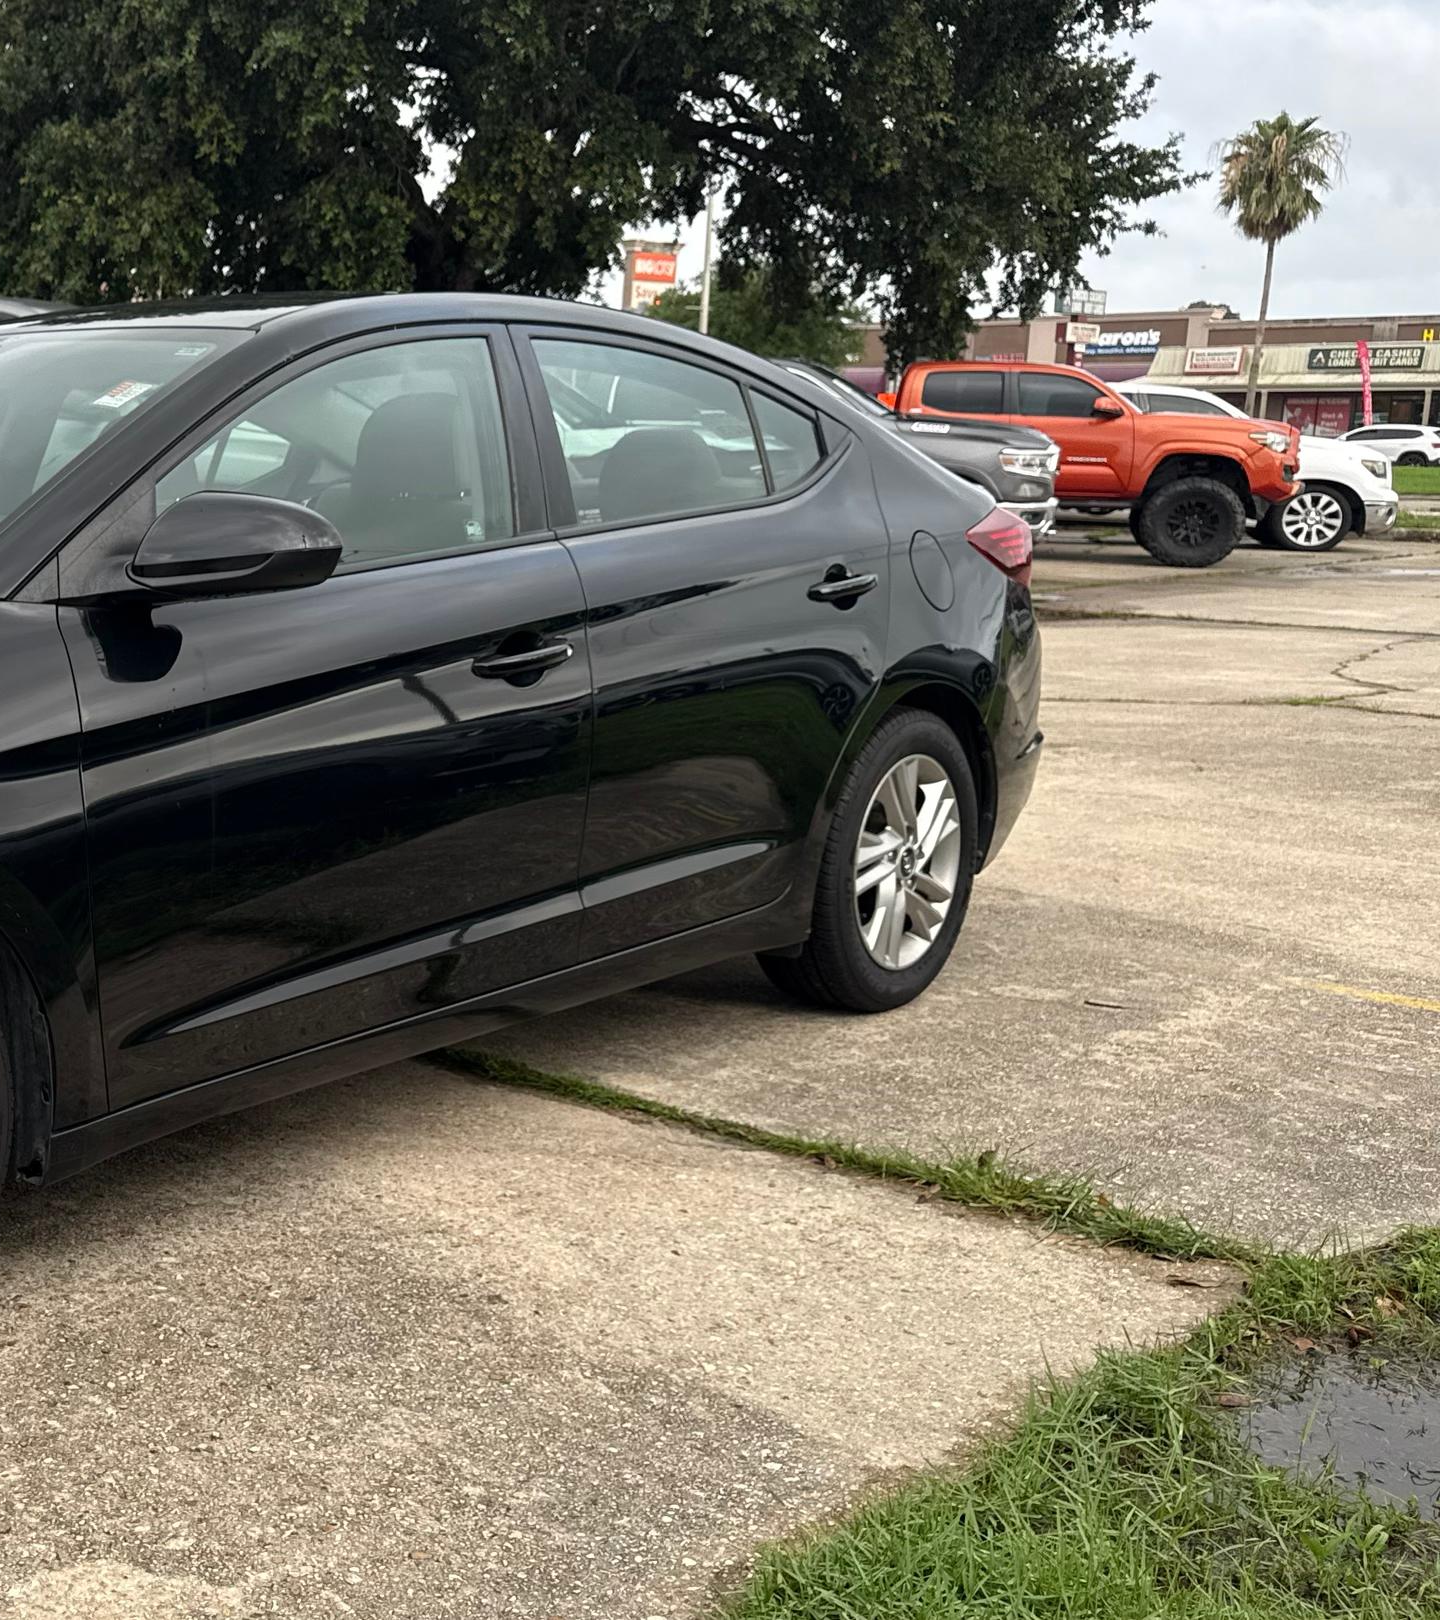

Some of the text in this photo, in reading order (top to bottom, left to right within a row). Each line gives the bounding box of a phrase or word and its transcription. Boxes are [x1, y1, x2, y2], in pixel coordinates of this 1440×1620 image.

[1098, 329, 1160, 346] aron's
[1329, 348, 1421, 358] CHEC CASHED
[1327, 357, 1420, 366] LOANS EBIT CARDS
